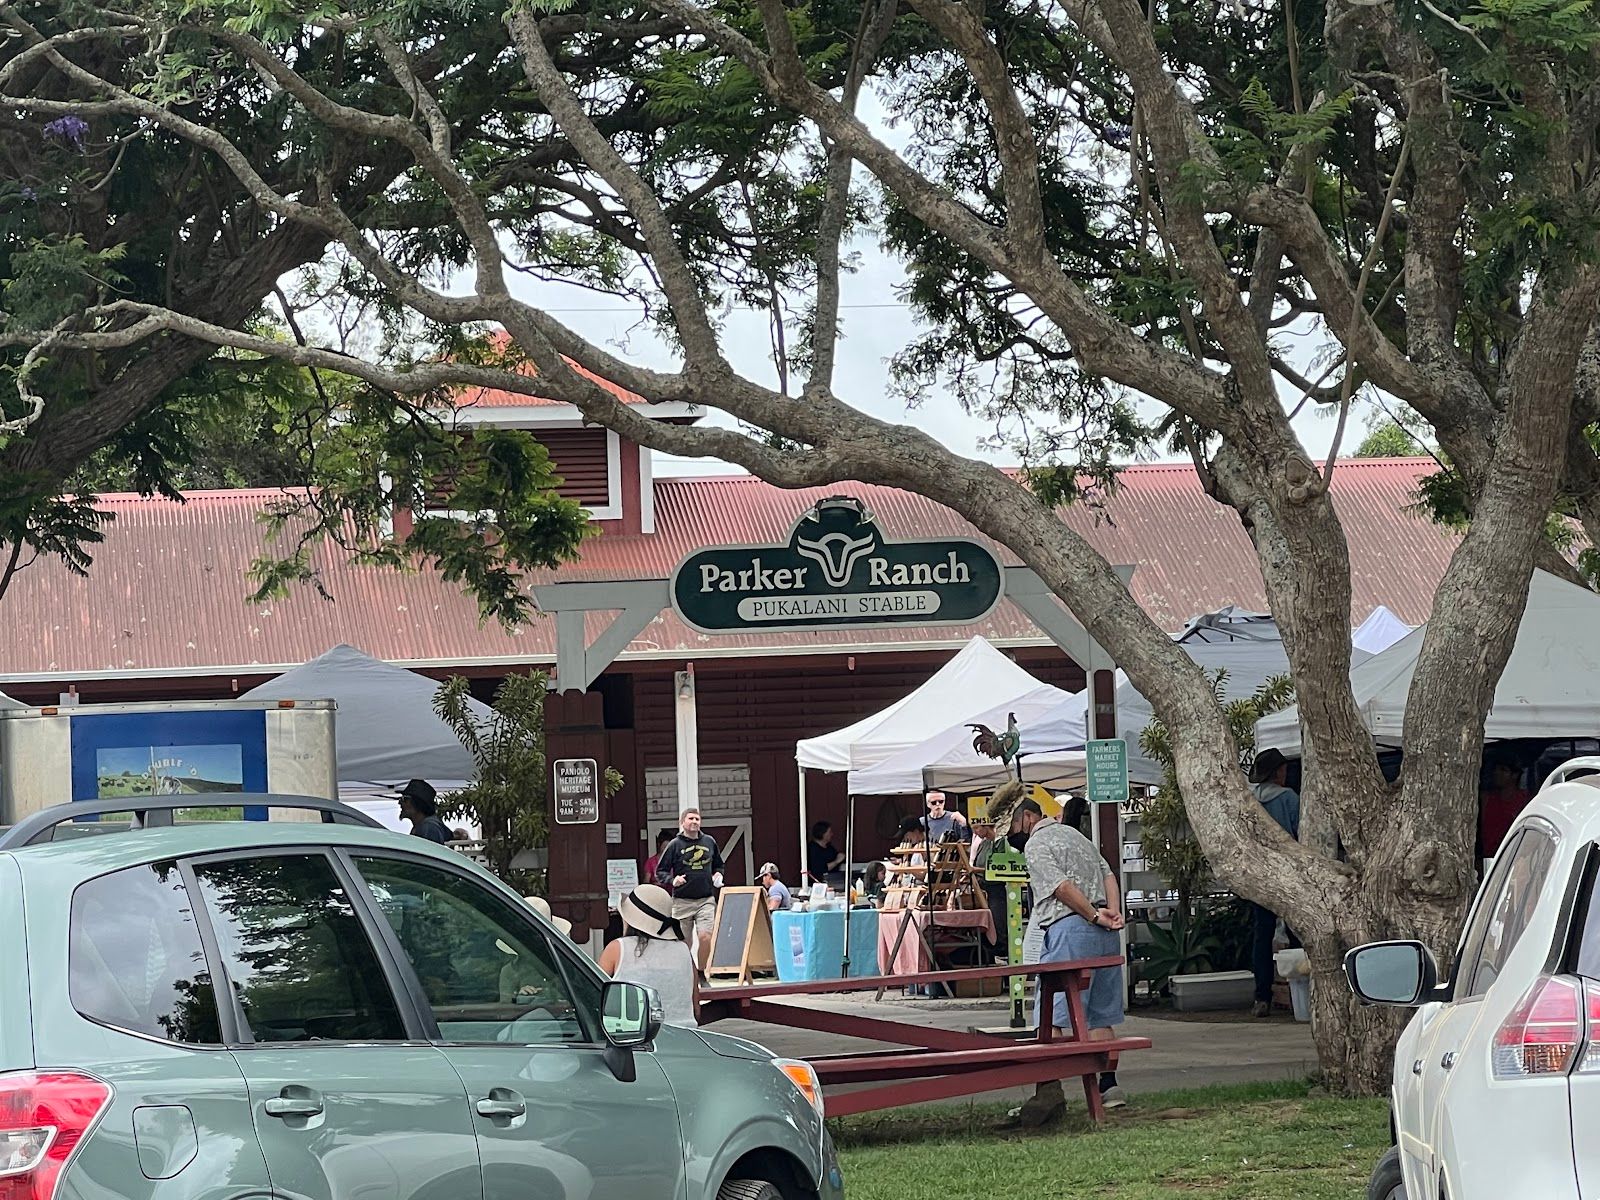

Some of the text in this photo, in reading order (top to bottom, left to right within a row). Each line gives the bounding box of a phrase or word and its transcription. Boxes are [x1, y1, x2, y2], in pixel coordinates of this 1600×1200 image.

[699, 551, 971, 593] Parker Ranch
[752, 595, 927, 617] PUKALANI STABLE
[1092, 745, 1121, 753] FARMERS
[1094, 753, 1120, 761] MARKET
[560, 767, 590, 776] PANIOLO
[559, 776, 592, 785] HERITAGE
[561, 785, 591, 793] MUSEUM
[561, 799, 573, 807] TUE
[579, 798, 592, 806] SAT
[559, 807, 574, 815] 9AM
[580, 806, 595, 815] 2PM
[1008, 860, 1028, 871] TRUC
